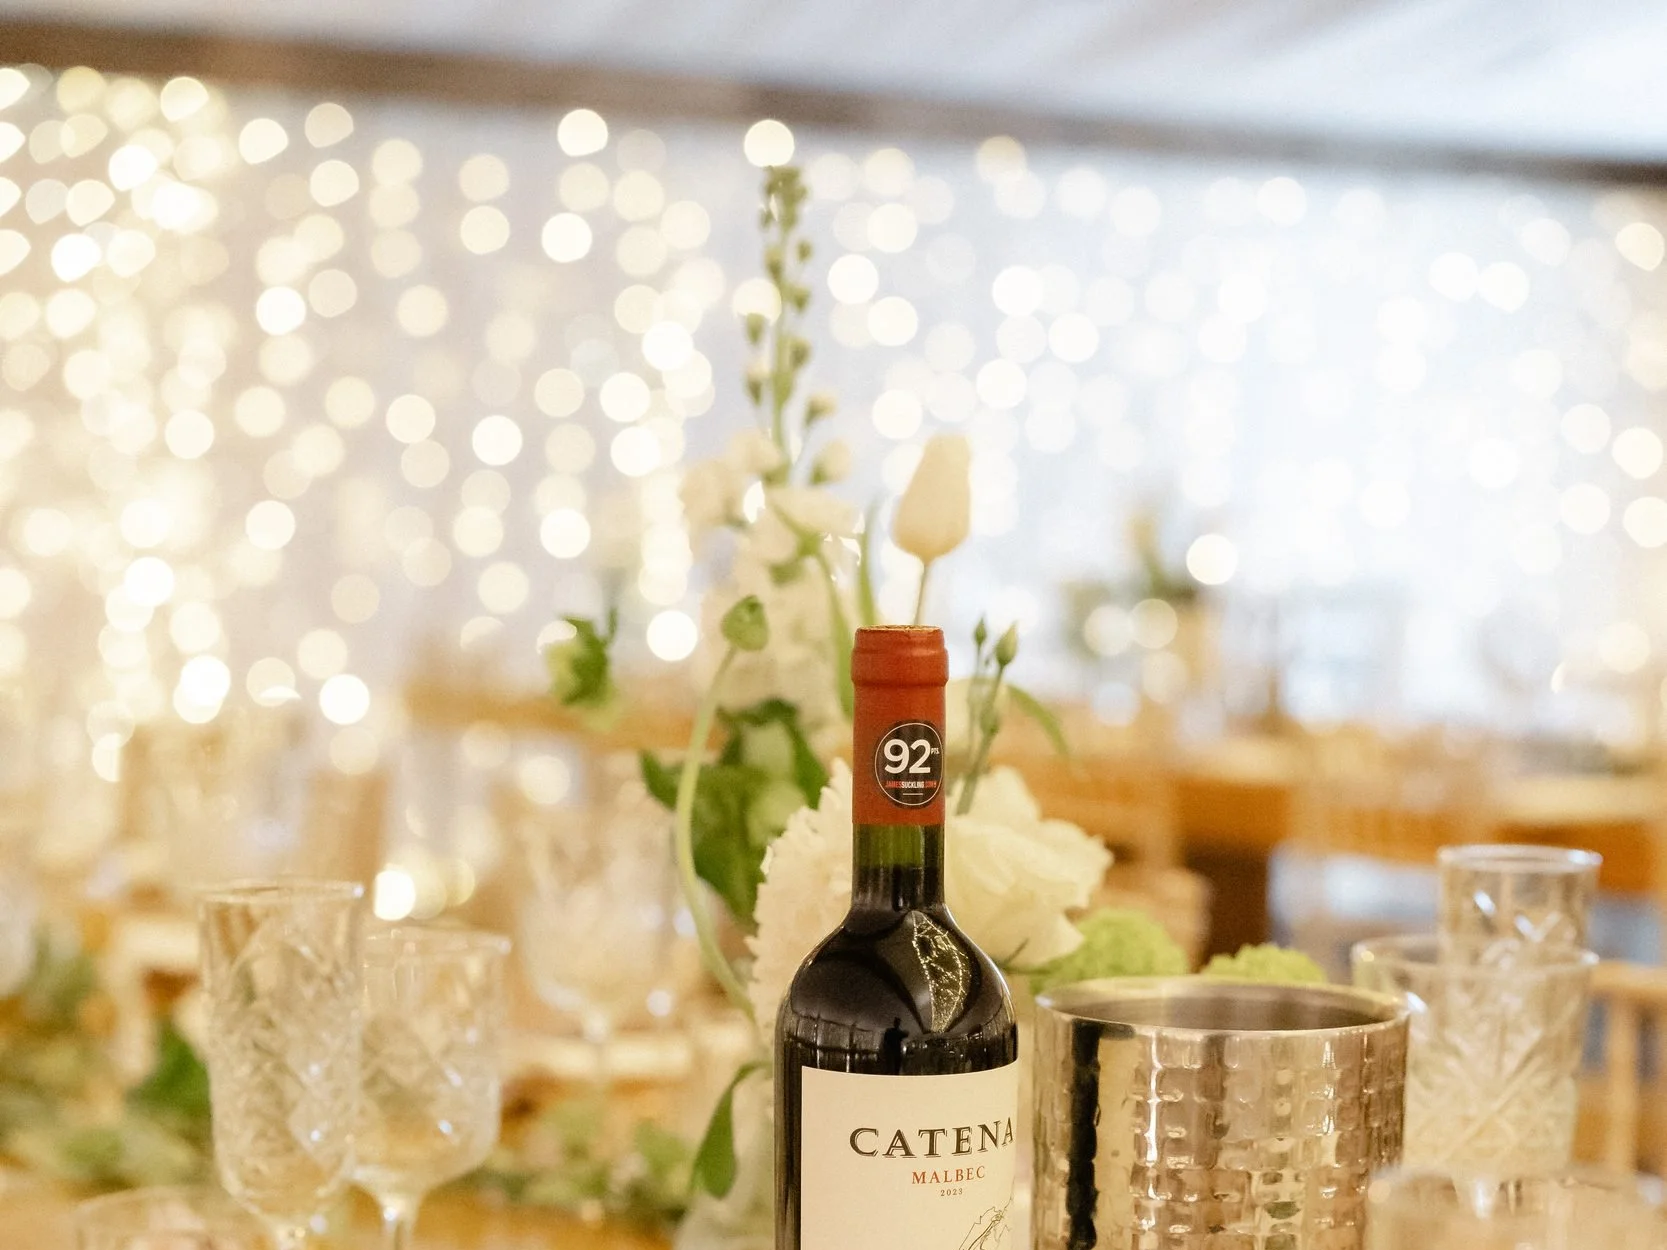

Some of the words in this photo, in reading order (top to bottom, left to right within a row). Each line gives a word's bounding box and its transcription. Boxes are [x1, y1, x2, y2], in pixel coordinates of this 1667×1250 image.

[884, 739, 931, 774] 92
[849, 1116, 1015, 1159] CATENA
[911, 1165, 986, 1185] MALBEC
[940, 1188, 964, 1197] 2023
